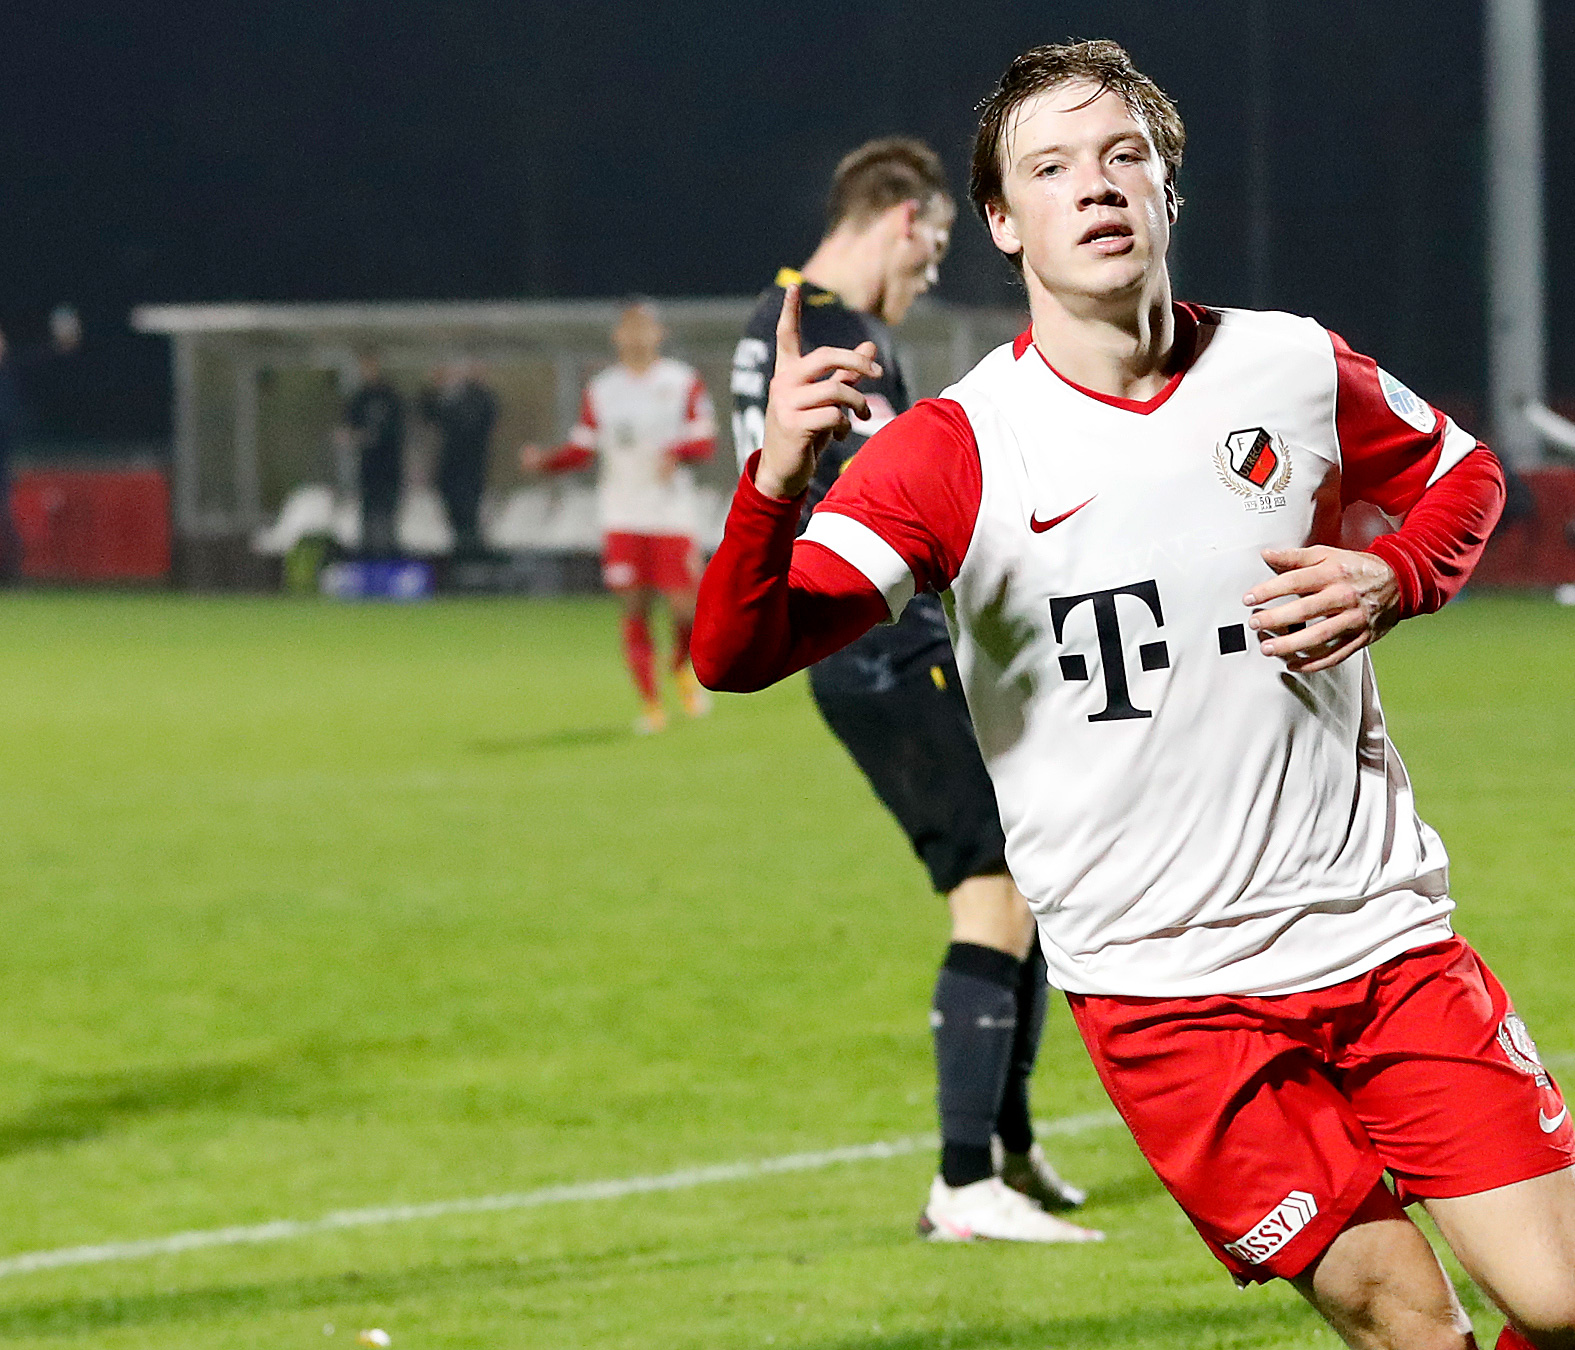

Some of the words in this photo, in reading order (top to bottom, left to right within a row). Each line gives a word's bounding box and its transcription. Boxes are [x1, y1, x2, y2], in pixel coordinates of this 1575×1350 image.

[1236, 437, 1245, 451] F
[1239, 432, 1269, 477] UTRECHT
[1260, 495, 1271, 505] 50
[1049, 579, 1166, 722] T
